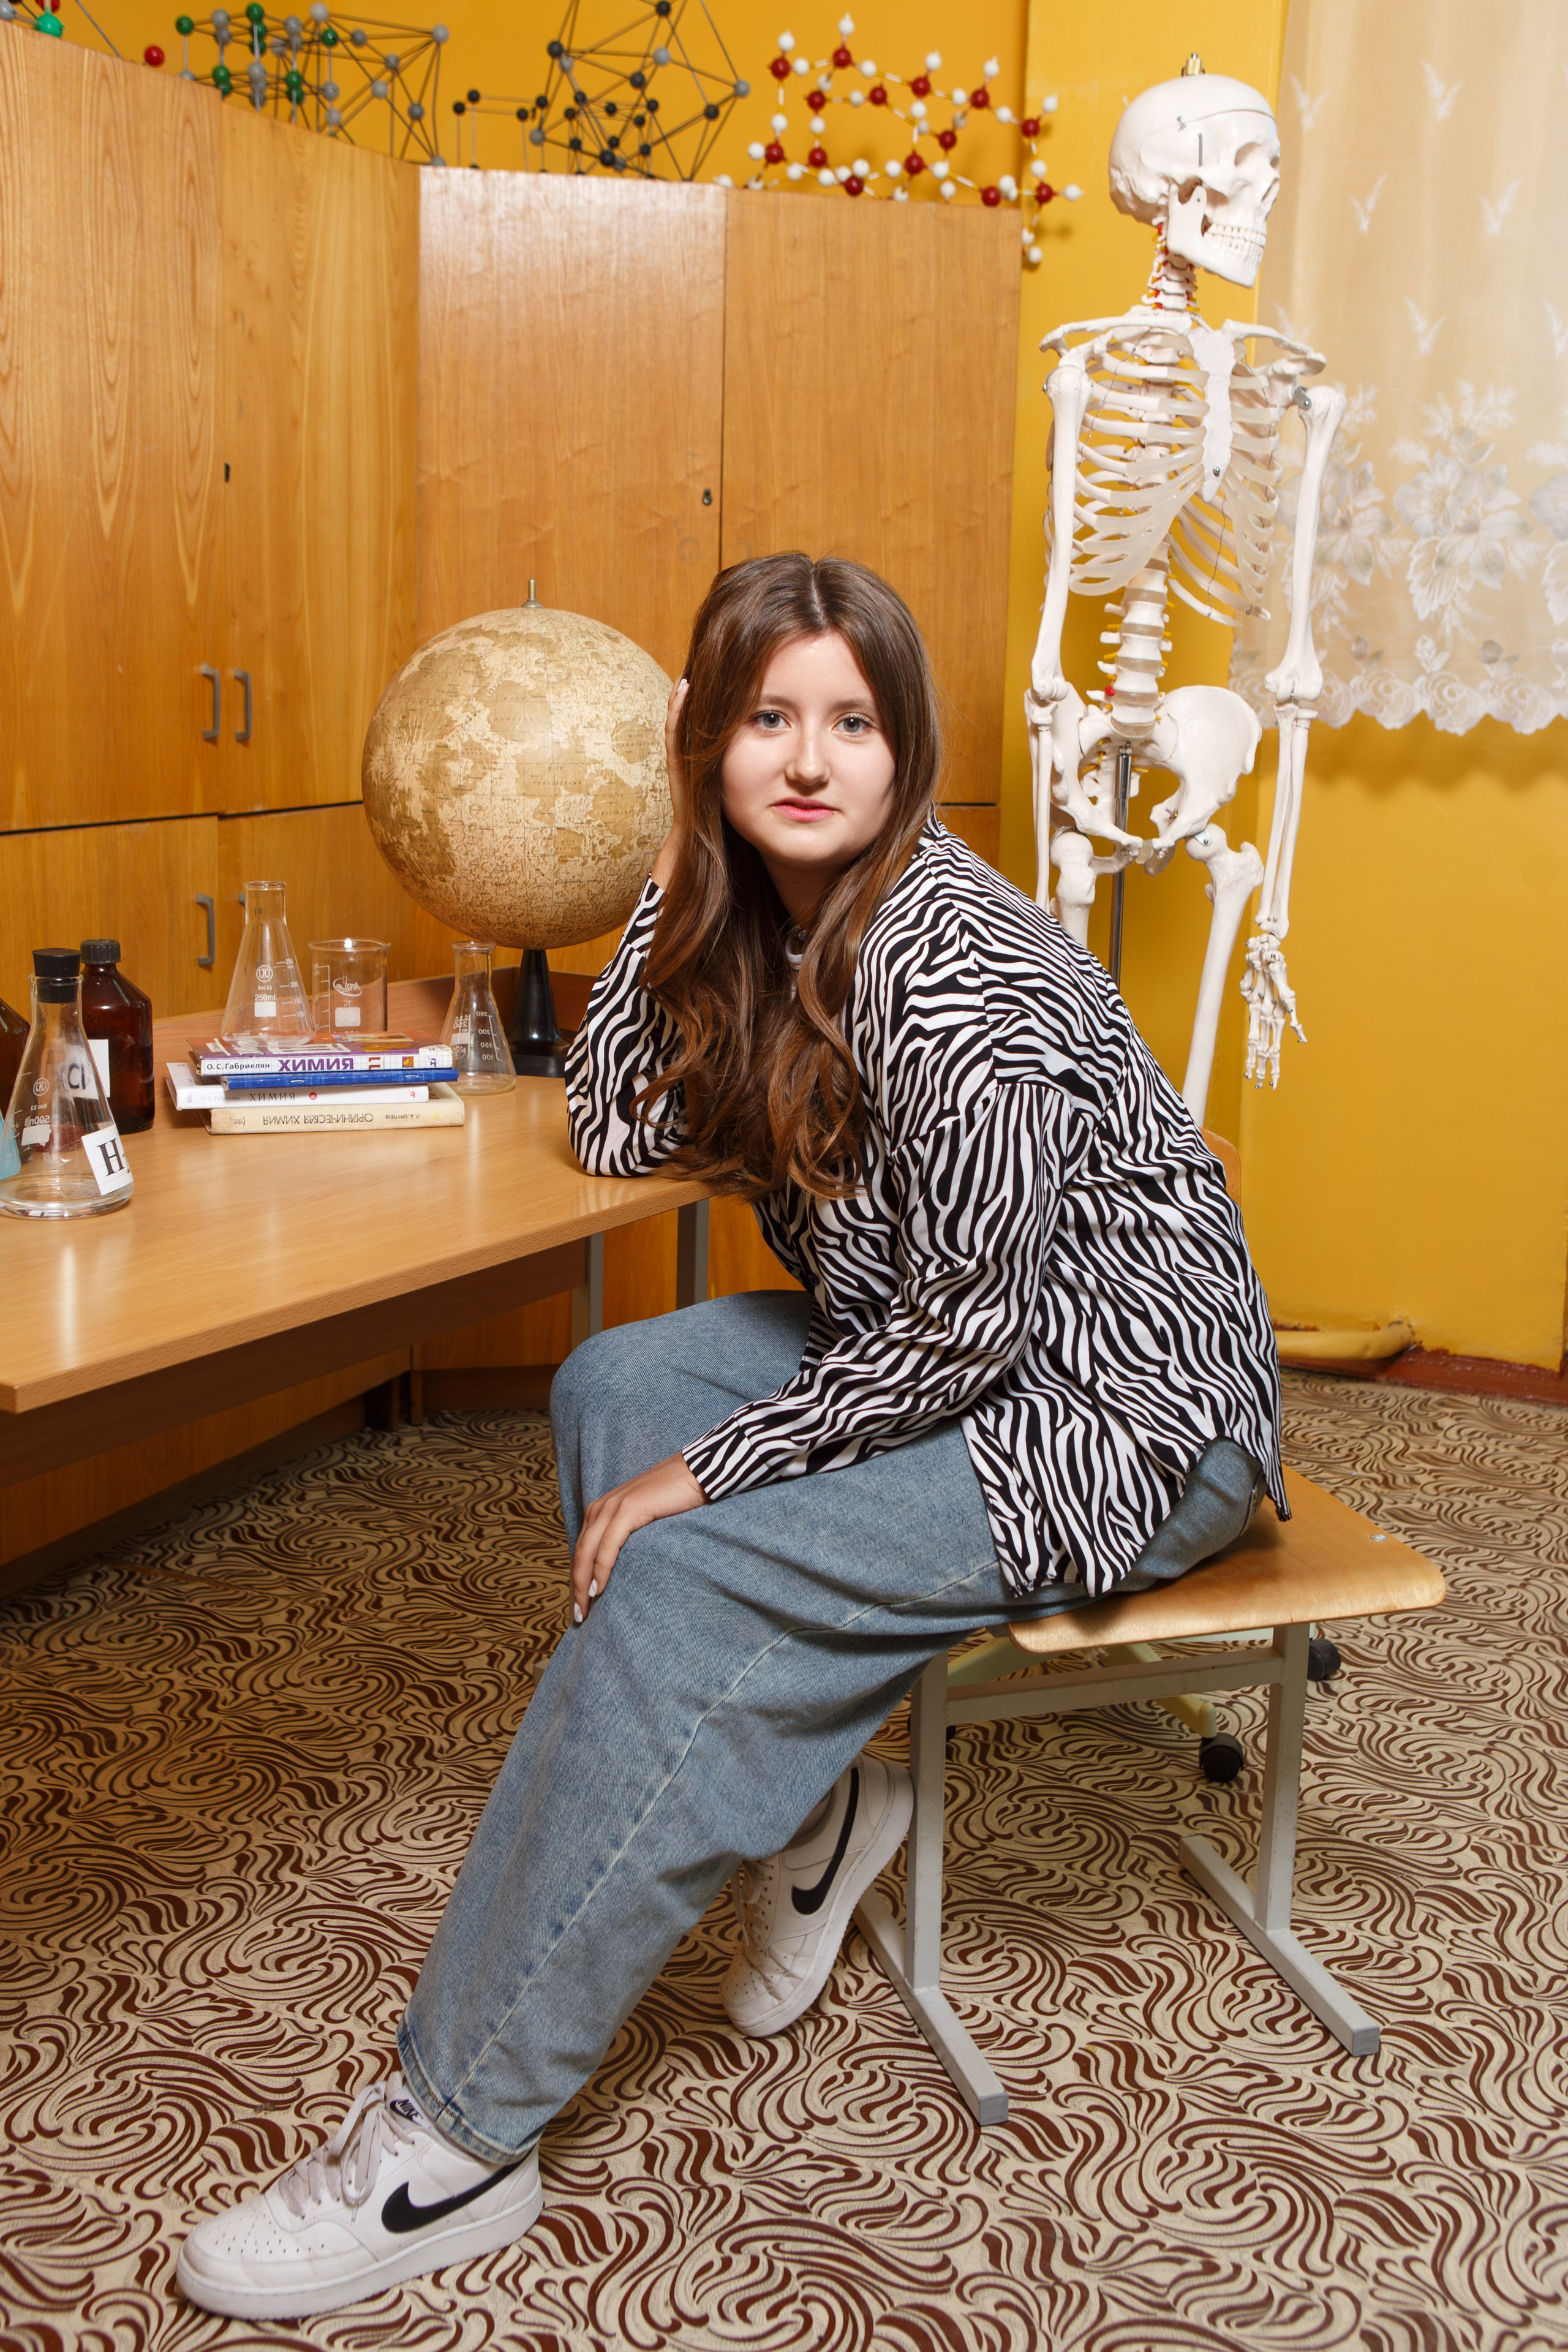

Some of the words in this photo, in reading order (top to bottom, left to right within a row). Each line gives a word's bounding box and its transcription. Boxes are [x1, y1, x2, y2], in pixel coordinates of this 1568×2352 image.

[278, 1058, 354, 1072] ХИМИЯ
[249, 1092, 295, 1102] ХИМИЯ
[263, 1115, 300, 1125] ХИМИЯ
[303, 1113, 374, 1125] ОРГАНИЧЕСКАЯ
